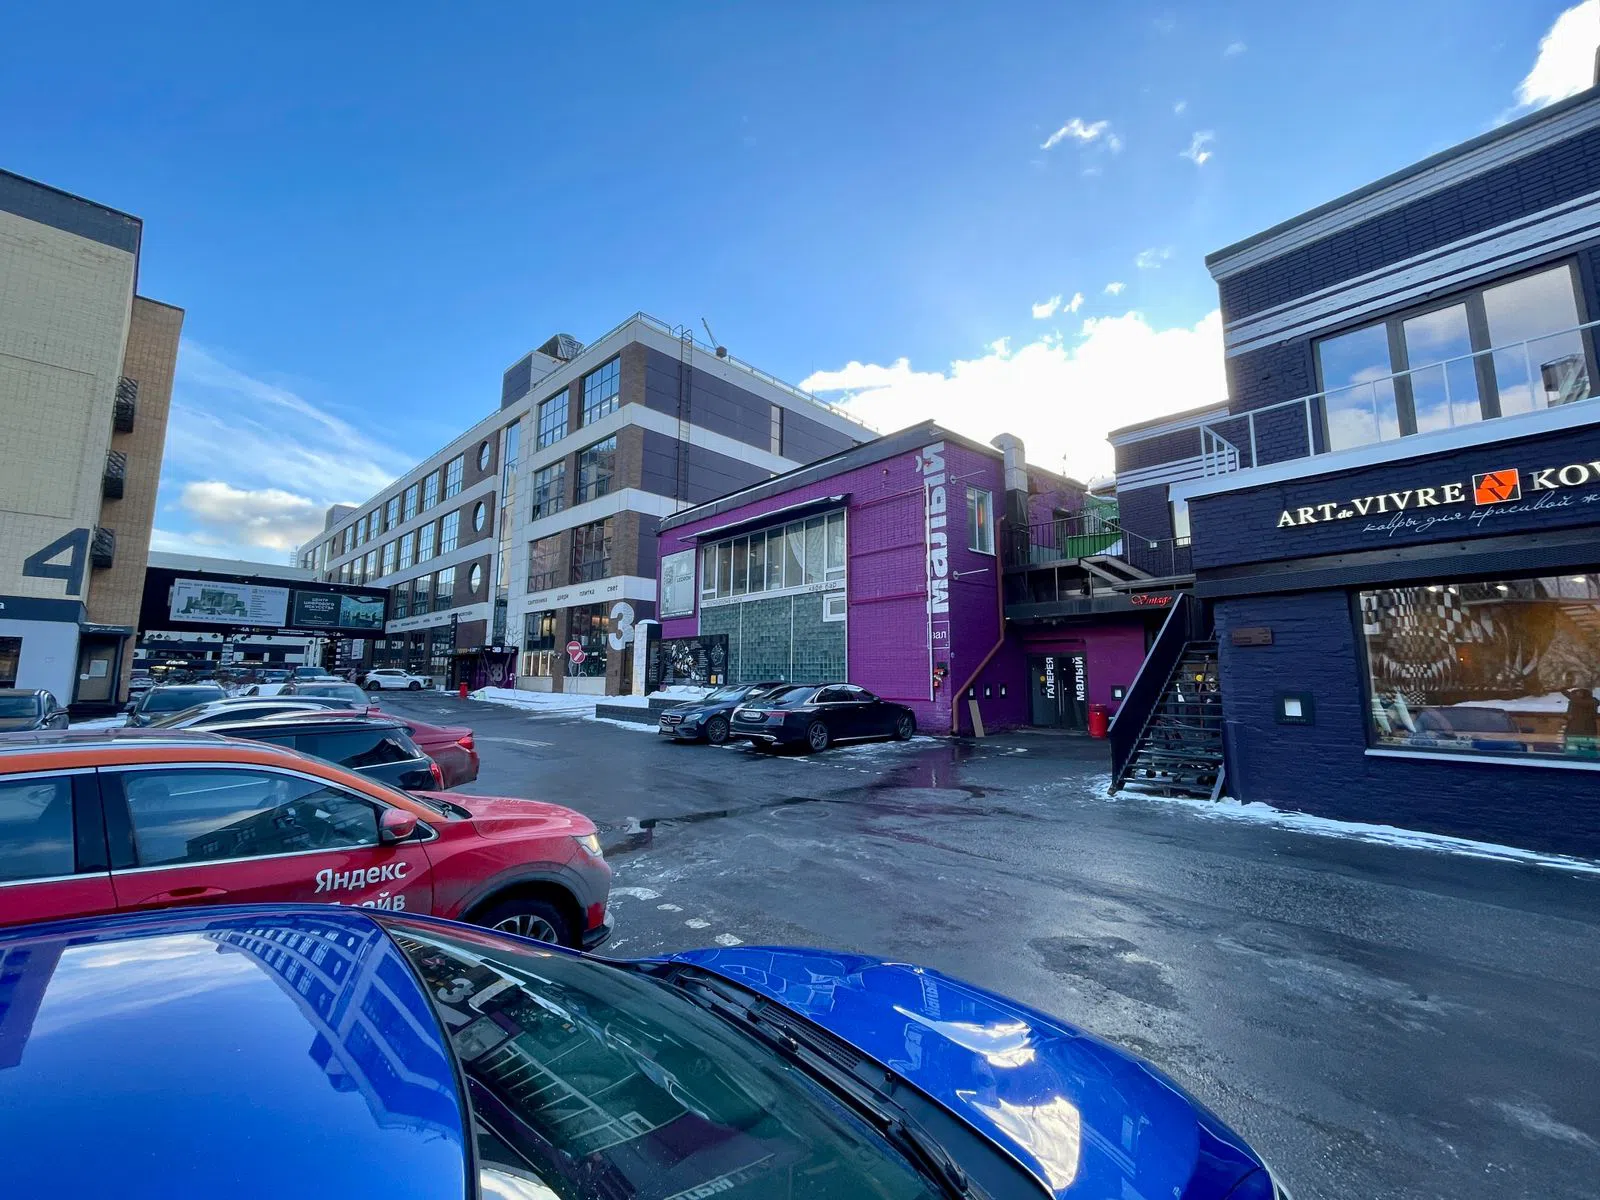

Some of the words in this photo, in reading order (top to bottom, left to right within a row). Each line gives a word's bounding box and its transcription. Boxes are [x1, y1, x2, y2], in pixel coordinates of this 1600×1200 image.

[915, 441, 949, 615] малый
[1276, 502, 1337, 528] ART
[1337, 509, 1354, 520] de
[1351, 483, 1465, 516] VIVRE
[1363, 511, 1420, 536] ковры
[1415, 512, 1465, 533] для
[1468, 490, 1575, 527] красивой
[23, 528, 90, 595] 4
[608, 601, 635, 650] 3
[1045, 657, 1055, 699] ГАЛЕРЕЯ
[1071, 656, 1085, 701] малый
[314, 862, 407, 894] Яндекс
